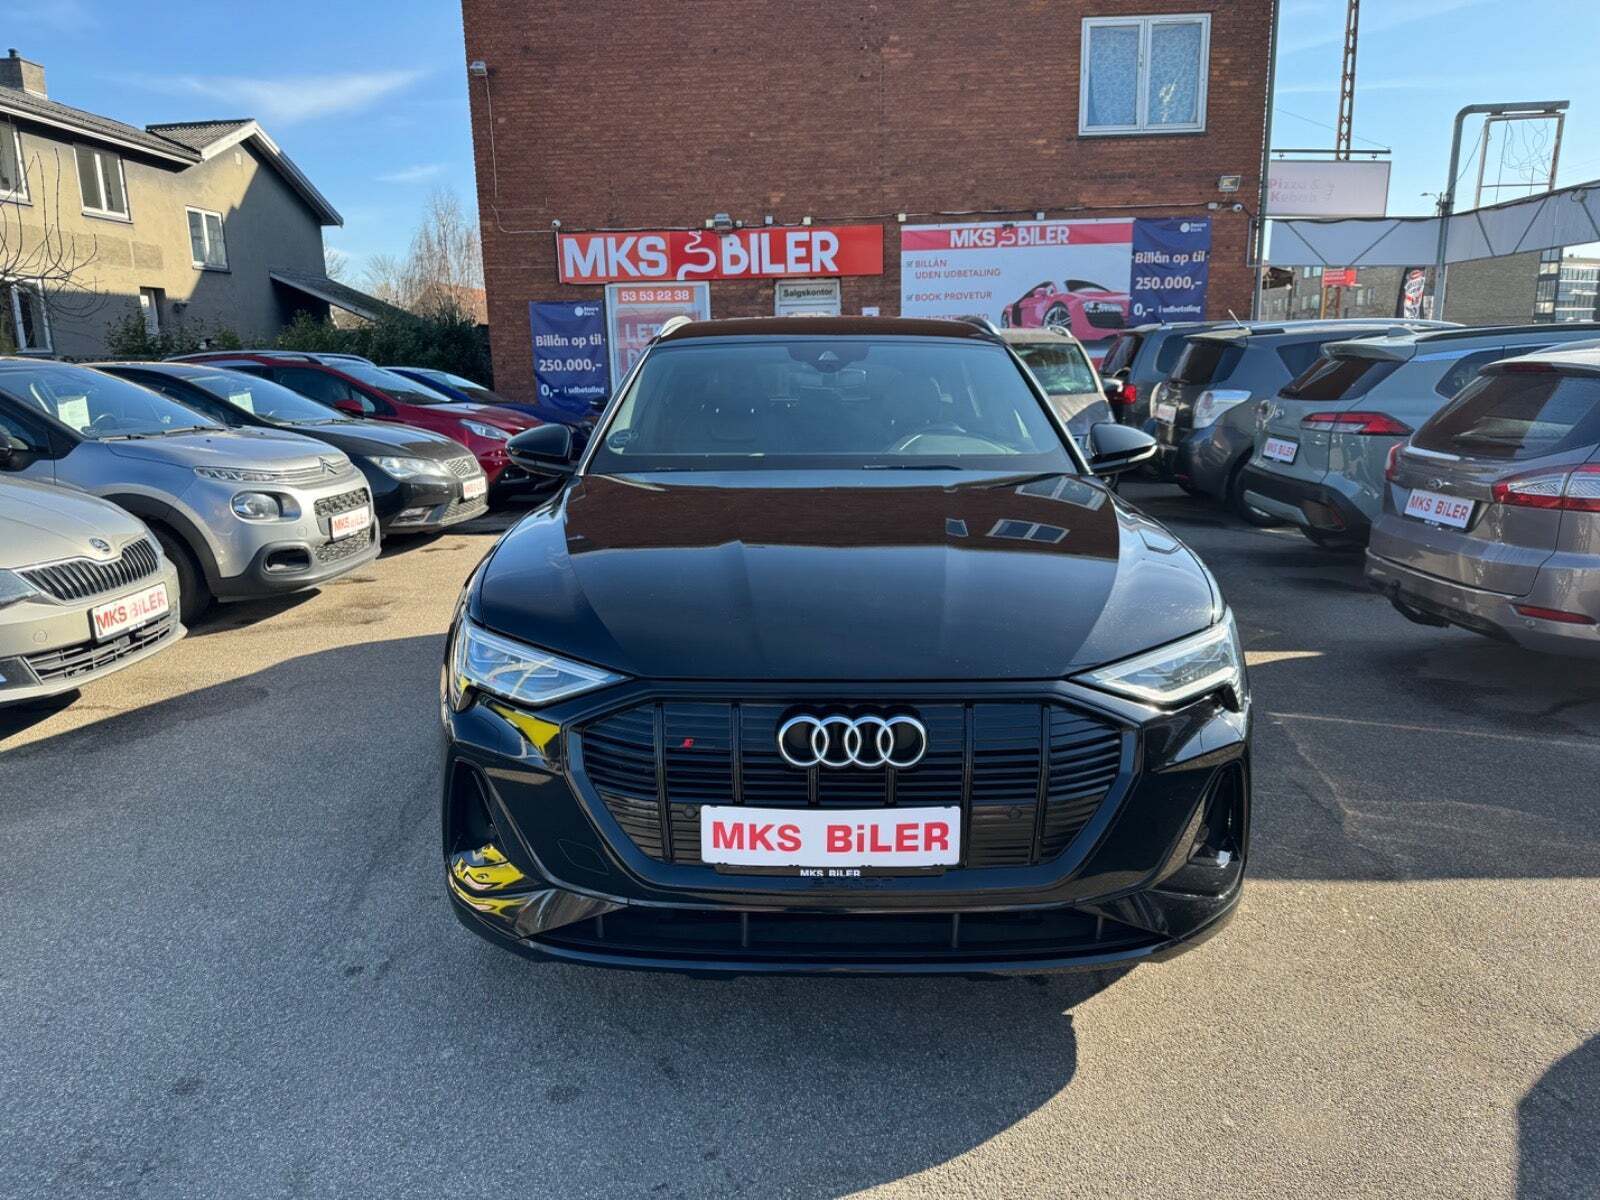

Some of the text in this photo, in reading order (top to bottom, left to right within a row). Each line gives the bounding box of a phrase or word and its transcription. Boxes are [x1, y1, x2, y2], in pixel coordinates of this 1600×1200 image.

[949, 226, 1070, 249] MKS BILER
[563, 230, 840, 279] MKS BILER
[1134, 250, 1206, 266] Billån op til
[914, 267, 1002, 280] UDEN UDBETALING
[1135, 275, 1203, 290] 250.000,-
[621, 289, 690, 302] 53 53 22 38
[783, 287, 833, 298] Salgskontor
[914, 292, 942, 302] BOOK
[535, 333, 602, 349] Billån op til
[539, 358, 603, 373] 250.000,-
[1408, 495, 1432, 512] MKS
[95, 605, 128, 636] MKS
[711, 821, 950, 854] MKS BiLER
[800, 868, 825, 877] MKS
